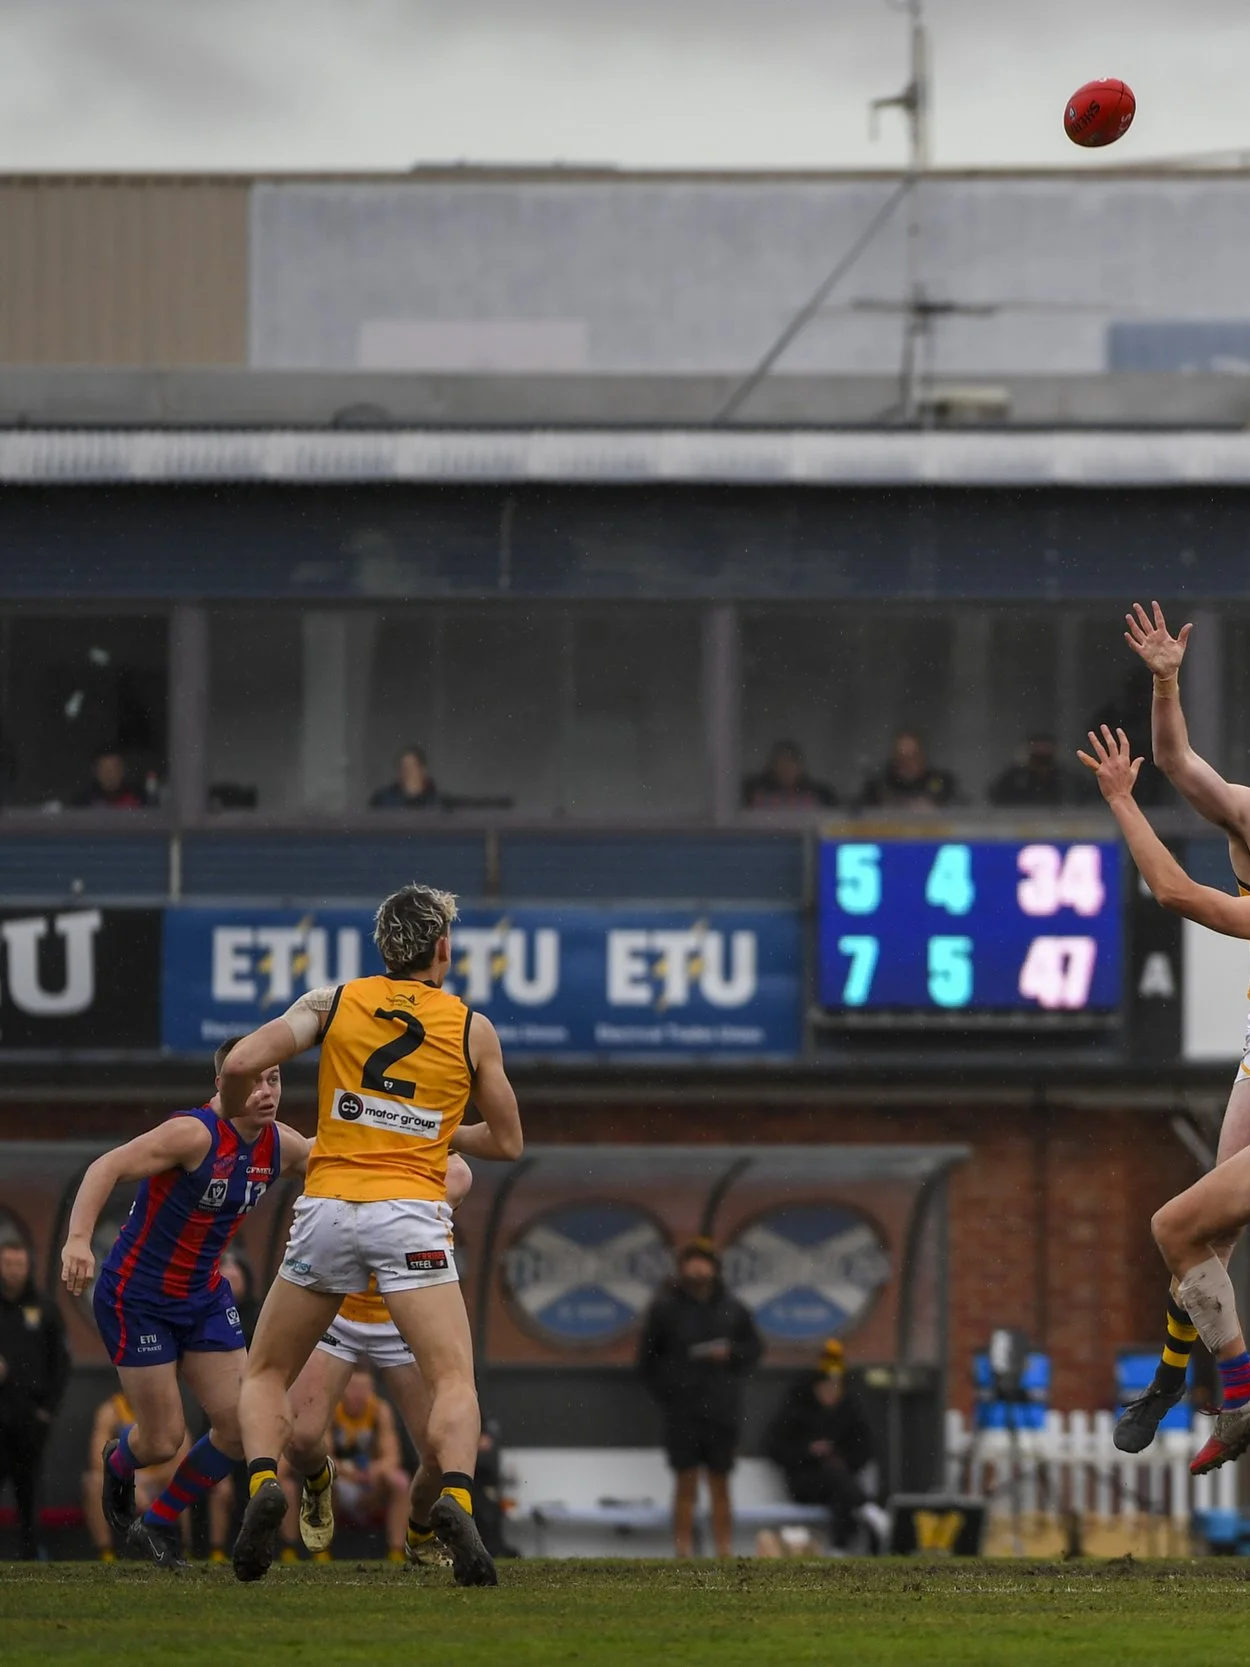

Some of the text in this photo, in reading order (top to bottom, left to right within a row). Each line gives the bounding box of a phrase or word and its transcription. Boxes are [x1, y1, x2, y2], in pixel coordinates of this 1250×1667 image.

[836, 844, 1104, 916] 5 4 34
[212, 925, 361, 1002] ETU
[442, 927, 559, 1006] TU
[606, 929, 757, 1007] ETU
[837, 936, 1097, 1008] 7 5 47
[1138, 953, 1175, 999] A
[361, 1007, 426, 1100] 2
[364, 1107, 400, 1121] motor
[400, 1115, 437, 1130] group
[410, 1260, 433, 1269] STEEL
[140, 1334, 157, 1345] ETU
